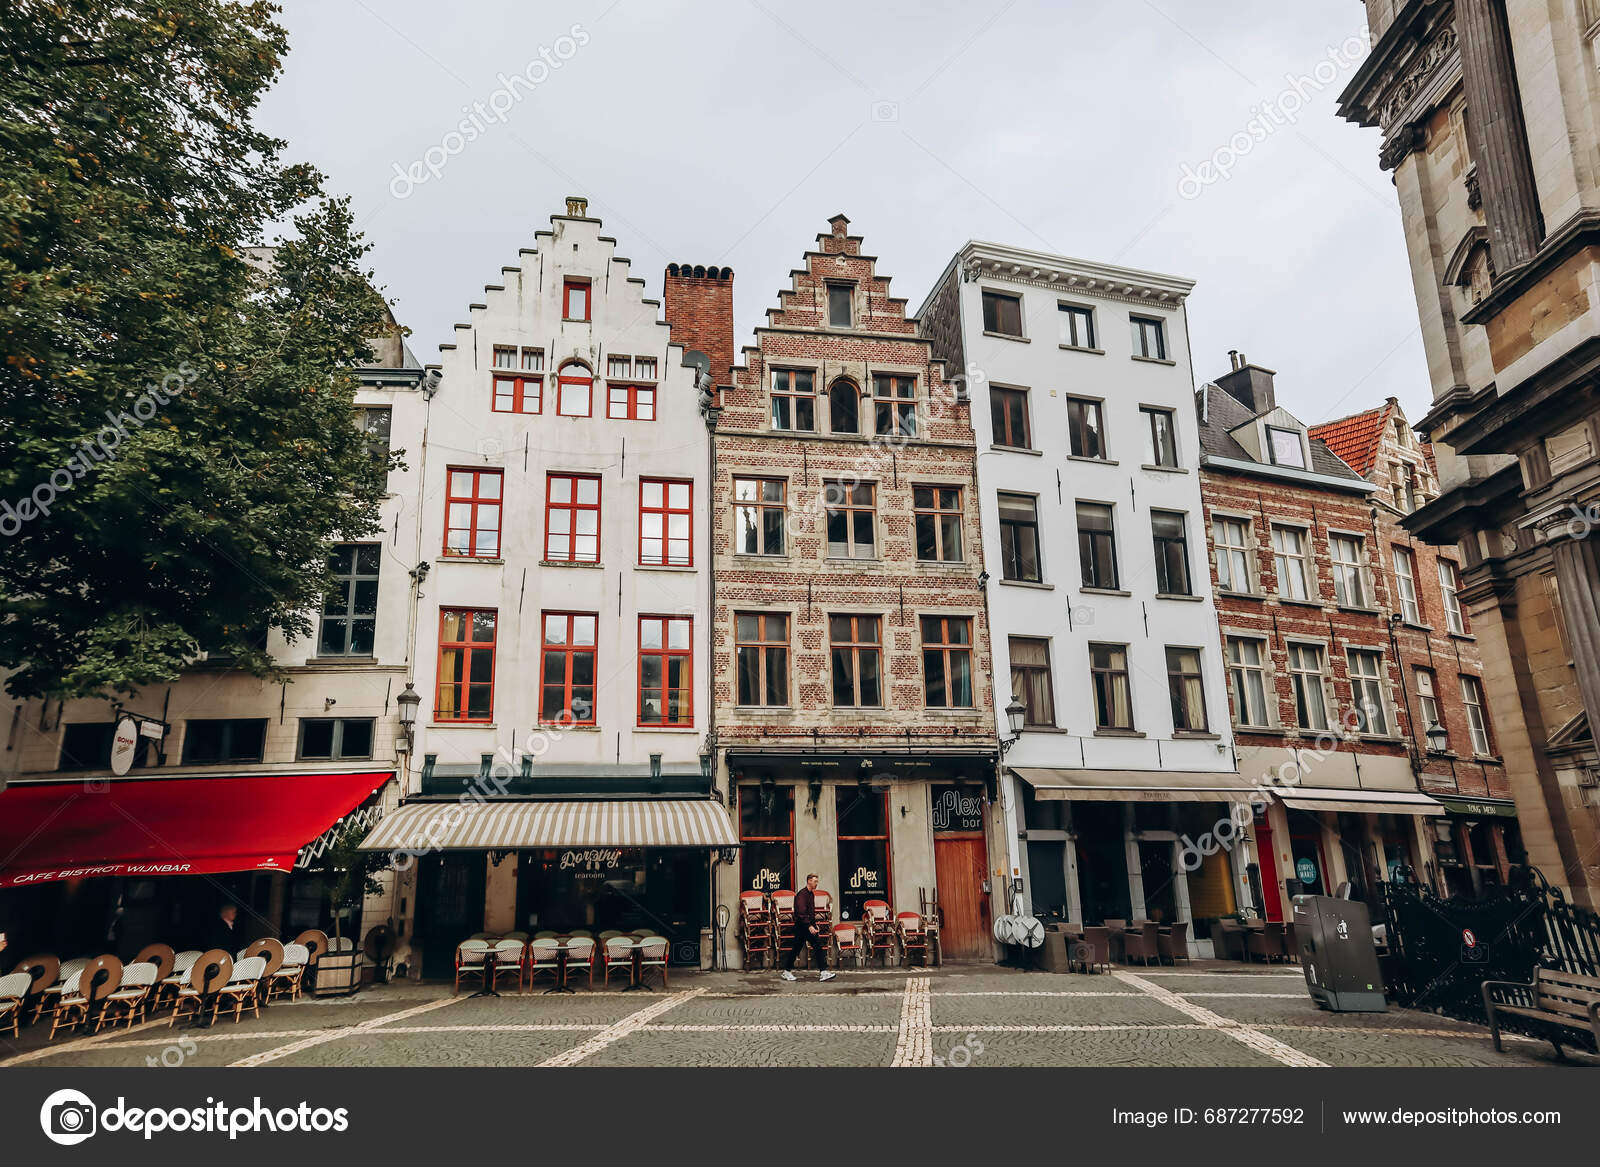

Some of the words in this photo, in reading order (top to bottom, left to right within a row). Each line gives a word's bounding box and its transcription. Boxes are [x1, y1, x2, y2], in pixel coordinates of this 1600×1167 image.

[962, 817, 981, 828] bar
[560, 849, 620, 870] Dorothy
[13, 871, 57, 884] CAFE
[58, 864, 124, 878] BISTROT
[866, 880, 878, 888] bar
